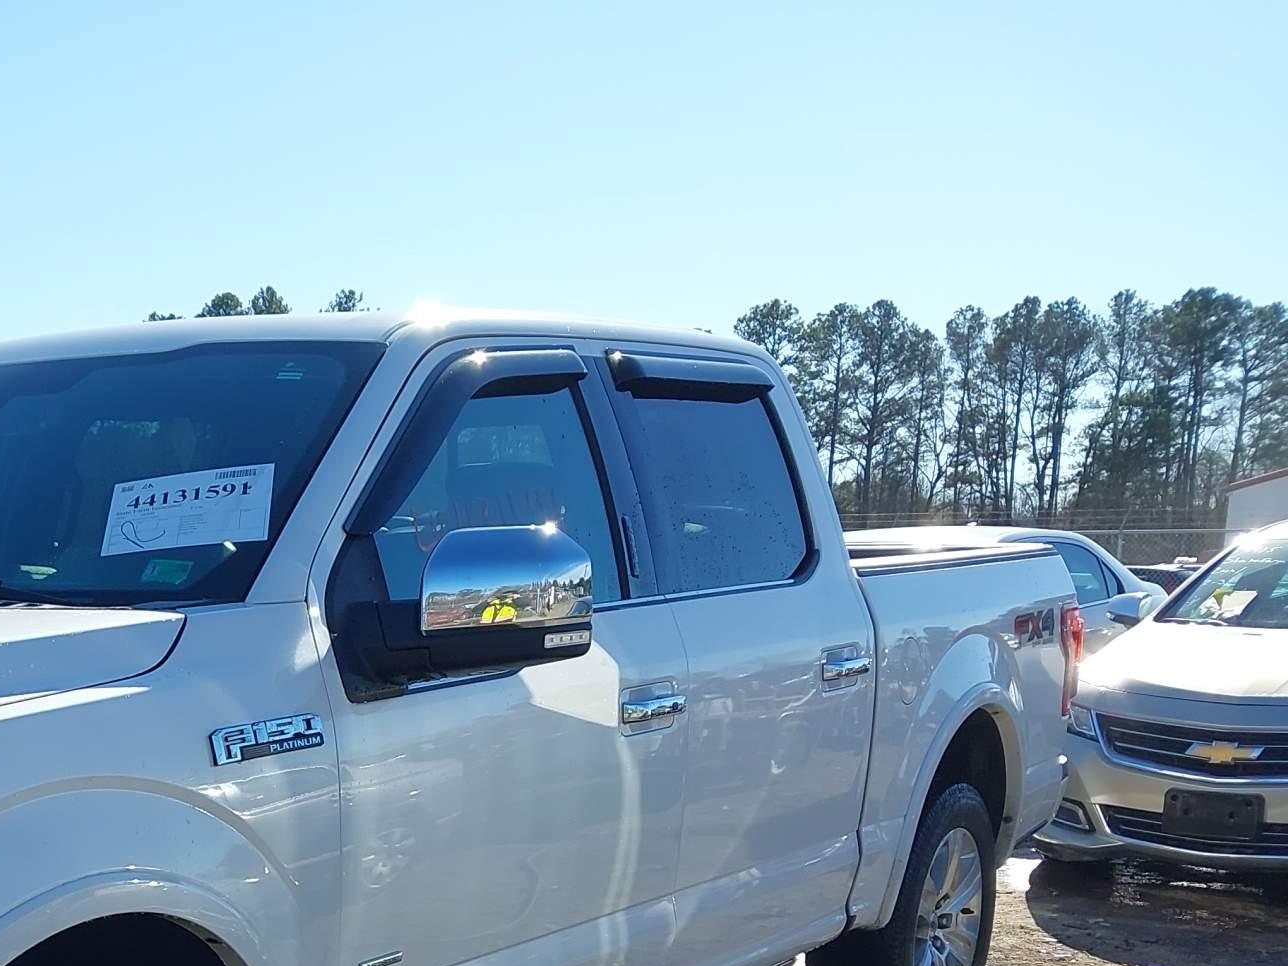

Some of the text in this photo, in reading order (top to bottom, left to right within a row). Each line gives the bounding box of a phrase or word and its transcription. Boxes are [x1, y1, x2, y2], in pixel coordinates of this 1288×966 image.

[126, 480, 253, 509] 44131591
[1014, 607, 1055, 642] FX4
[269, 735, 322, 753] PLATINUM
